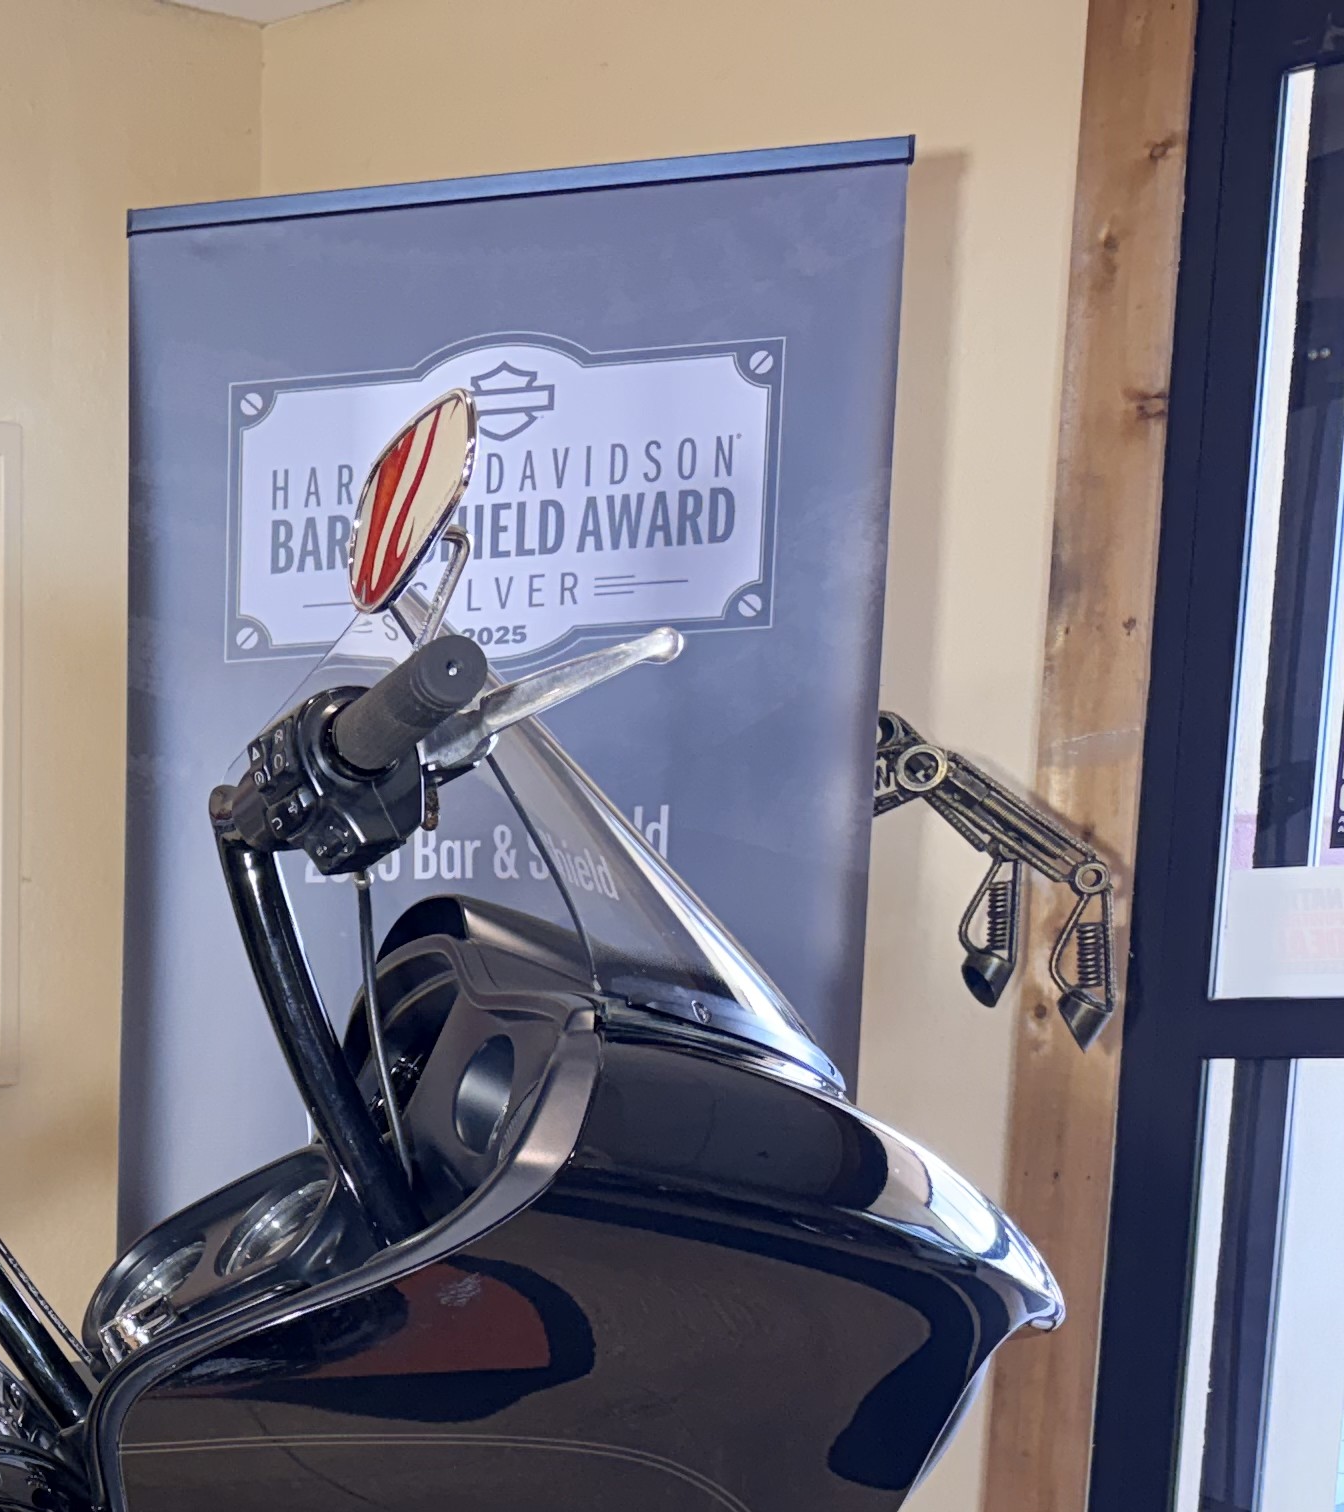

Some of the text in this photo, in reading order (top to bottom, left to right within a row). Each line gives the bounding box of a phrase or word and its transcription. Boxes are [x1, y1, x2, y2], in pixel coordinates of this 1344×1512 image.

[271, 434, 737, 511] HARDAVIDSON
[270, 486, 736, 575] BAR HIELD AWARD
[460, 624, 528, 647] 2025
[414, 825, 481, 881] Bar
[493, 823, 520, 880] &
